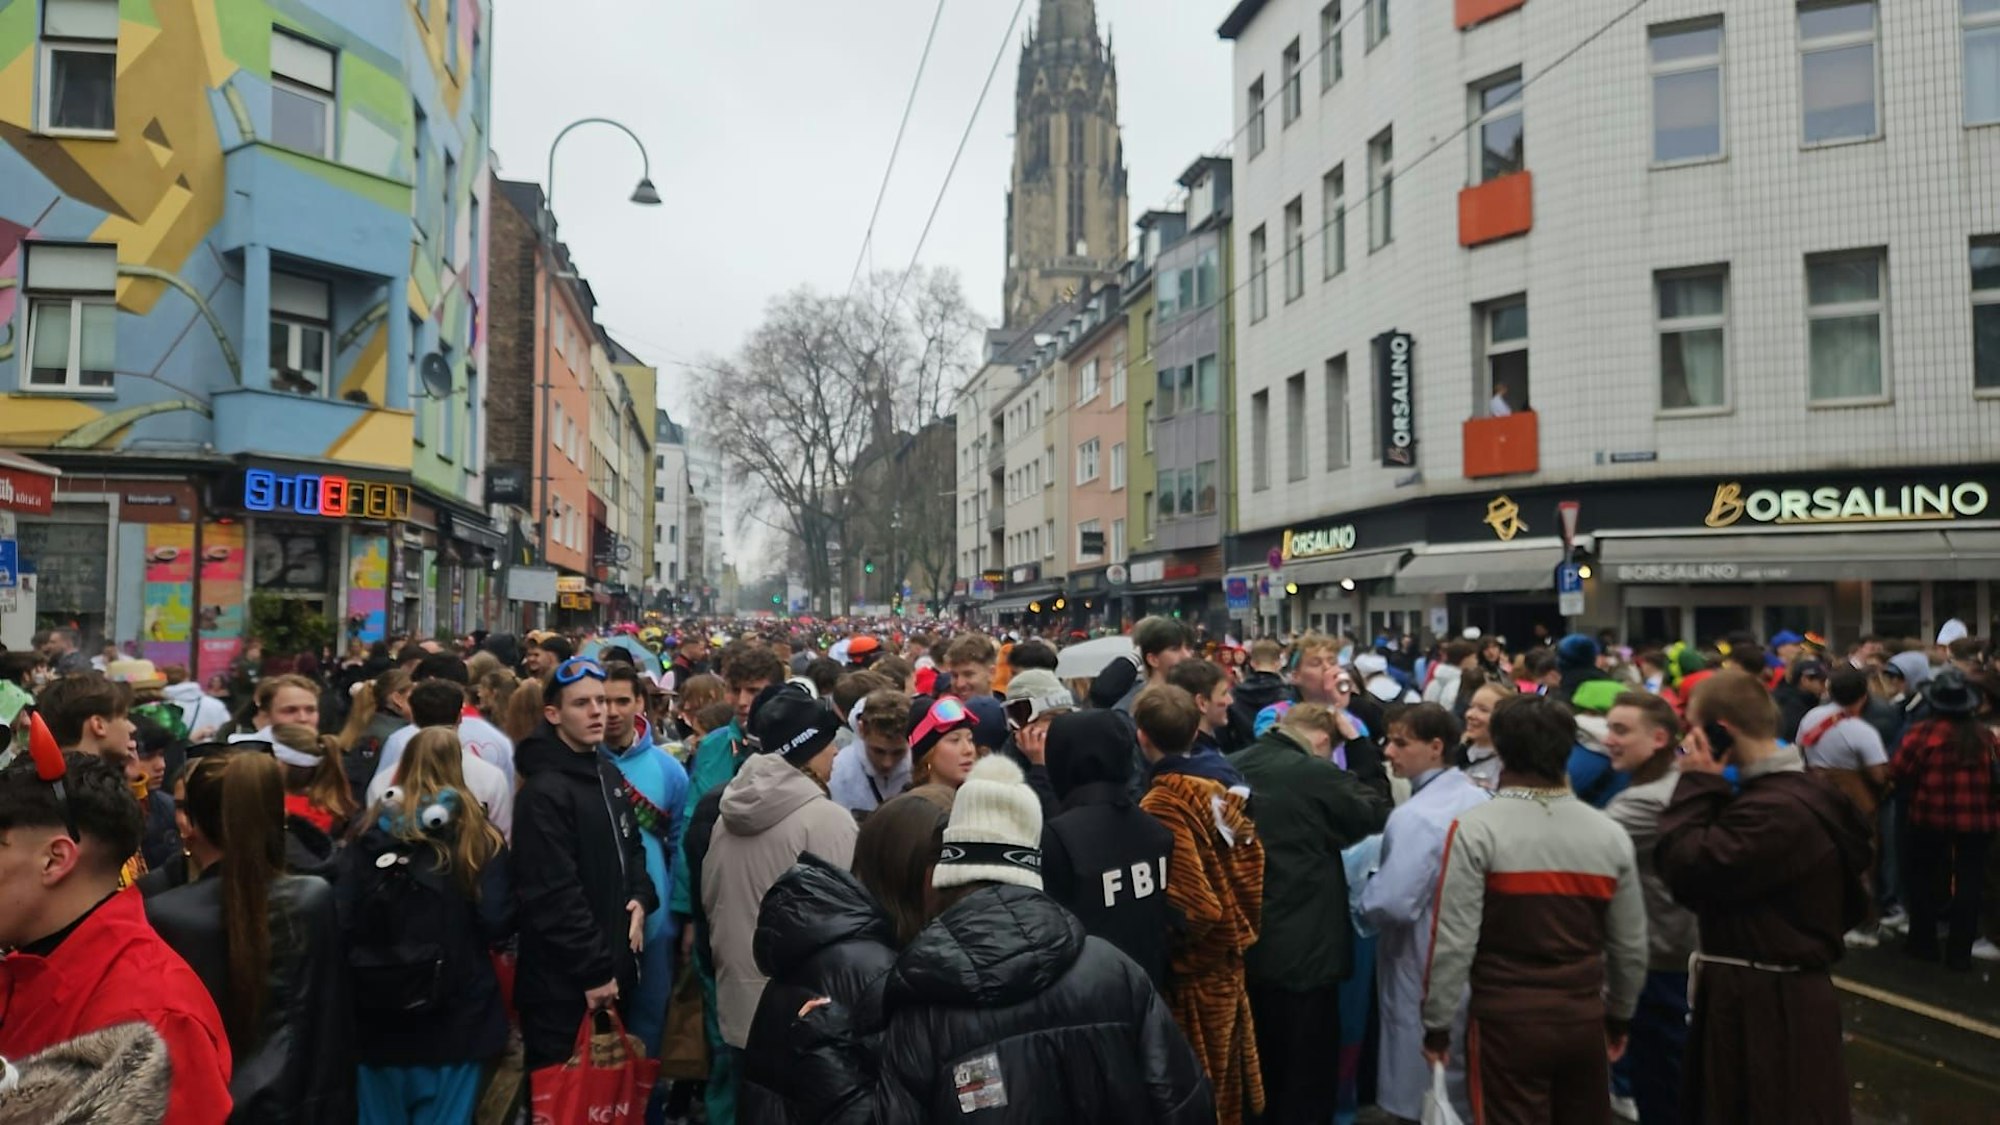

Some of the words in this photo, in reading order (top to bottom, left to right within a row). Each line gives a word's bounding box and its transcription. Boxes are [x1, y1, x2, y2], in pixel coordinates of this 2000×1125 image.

[1387, 335, 1411, 465] BORSALINO
[245, 469, 411, 519] STIEFEL
[1705, 481, 1989, 528] BORSALINO
[1281, 524, 1356, 560] BORSALINO
[1563, 568, 1578, 590] P
[1617, 564, 1739, 581] BORSALINO
[1102, 856, 1167, 908] FBI
